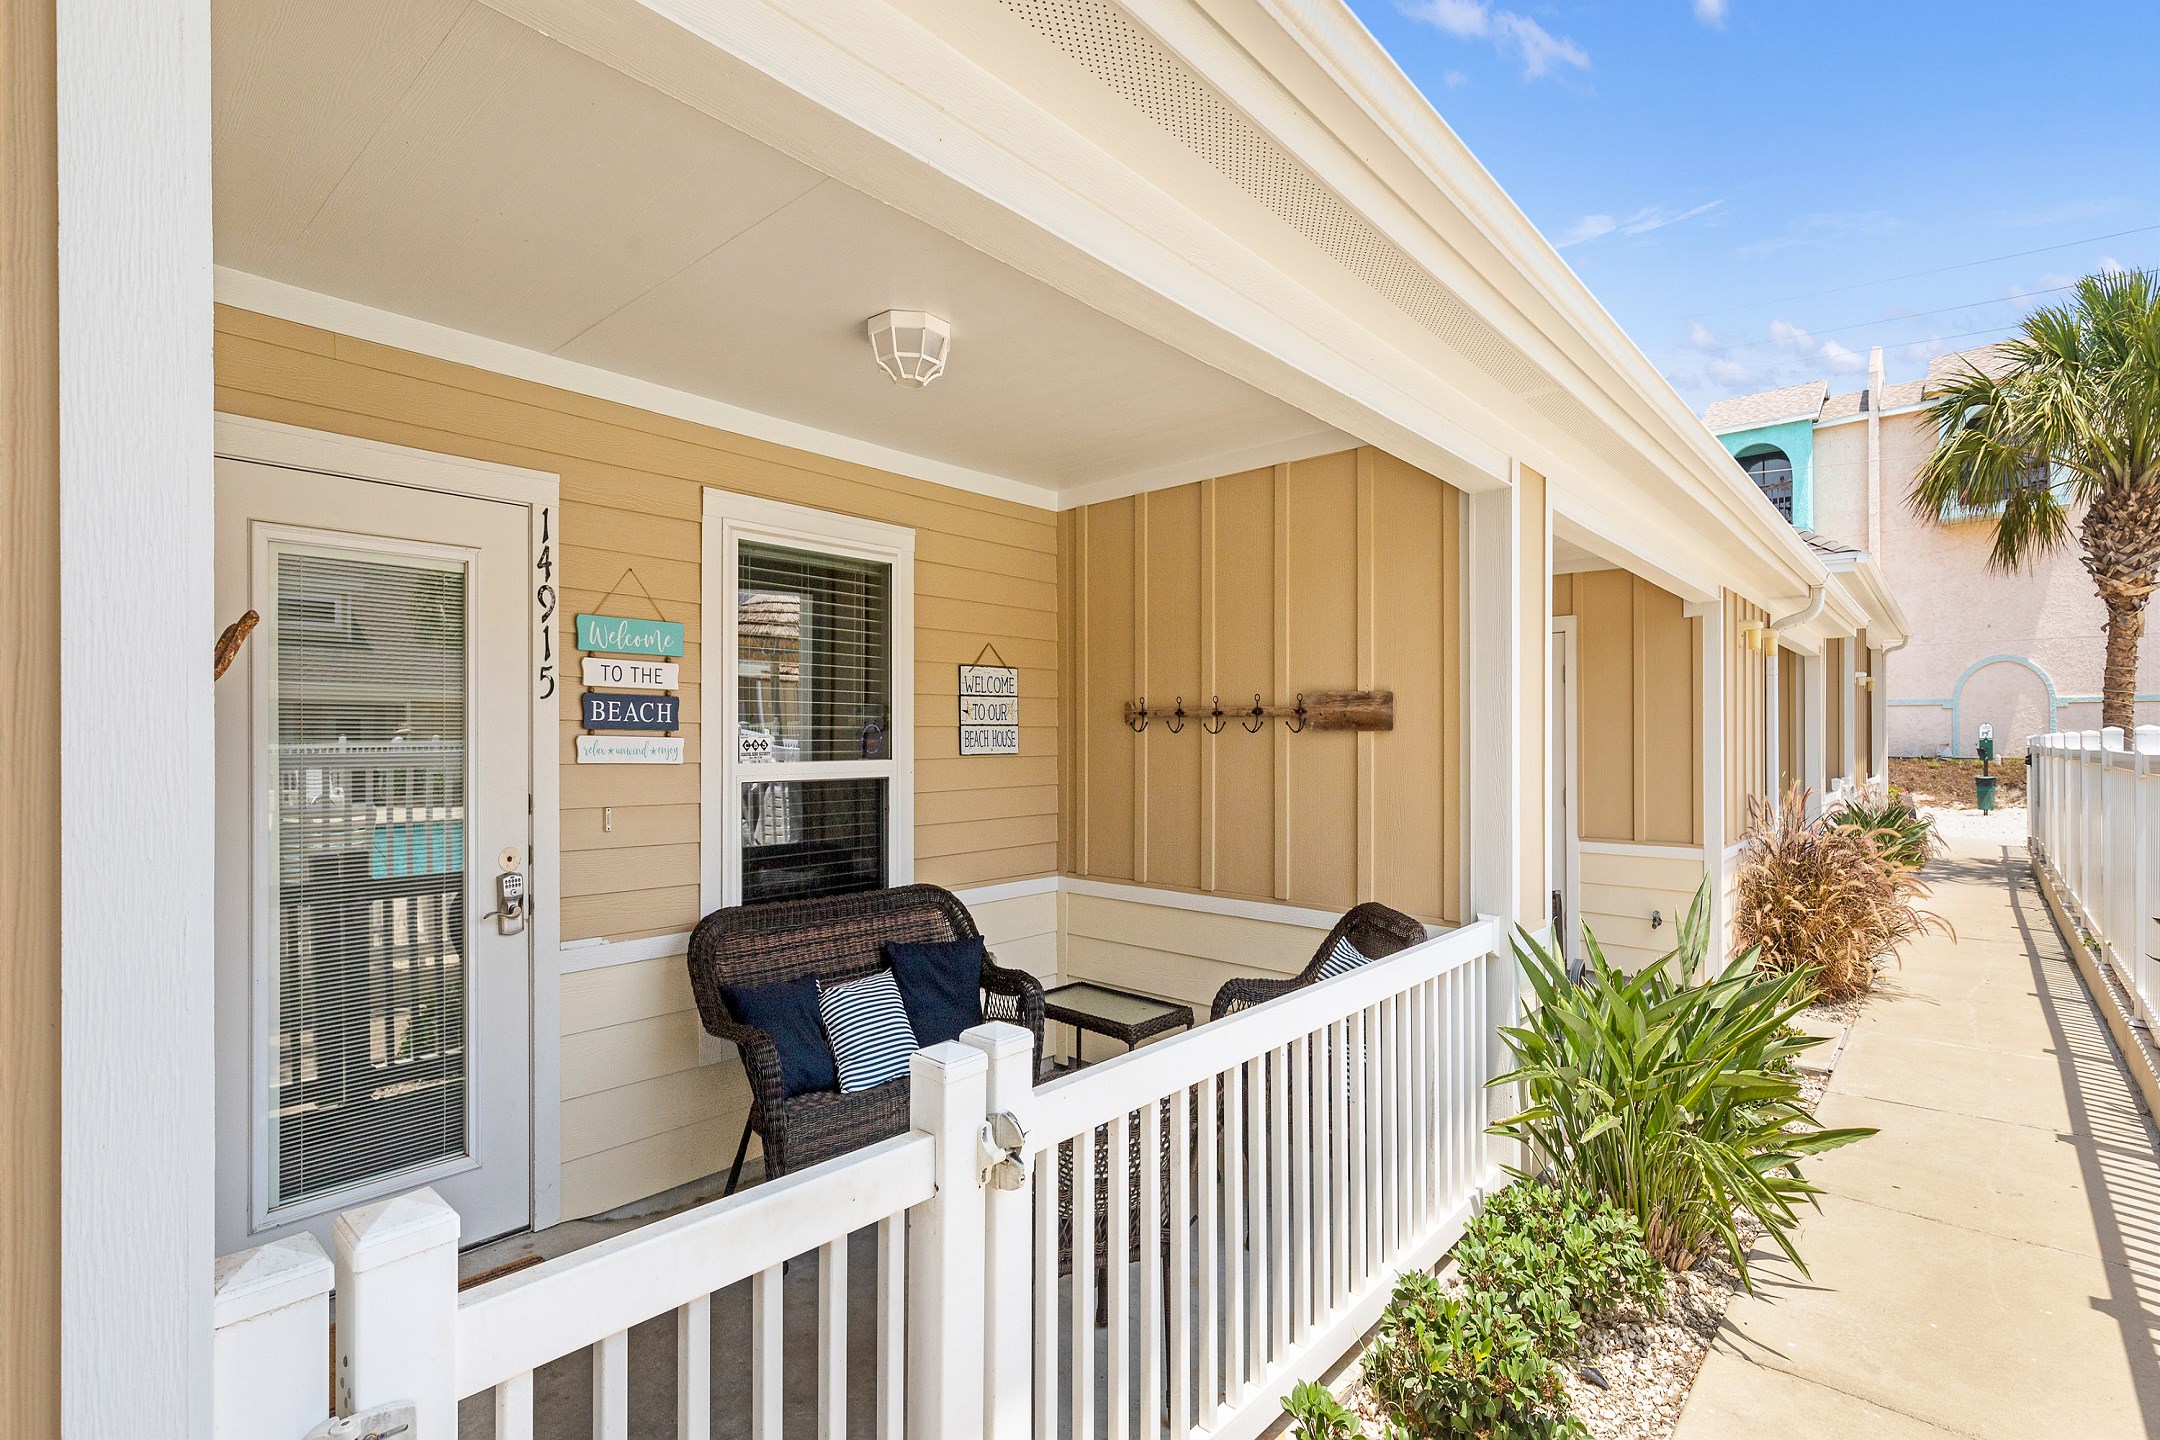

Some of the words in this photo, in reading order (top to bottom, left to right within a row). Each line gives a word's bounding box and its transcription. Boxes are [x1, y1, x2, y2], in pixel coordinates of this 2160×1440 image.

[537, 507, 556, 700] 14915
[589, 620, 675, 653] Welcome
[600, 664, 623, 683] TO
[630, 666, 664, 685] THE
[964, 675, 1015, 694] WELCOME
[590, 700, 673, 723] BEACH
[972, 703, 986, 721] TO
[988, 703, 1008, 721] OUR
[964, 729, 989, 748] BEACH
[992, 729, 1016, 748] HOUSE
[584, 739, 606, 757] relax
[615, 740, 650, 759] unwind
[657, 746, 680, 762] enjoy
